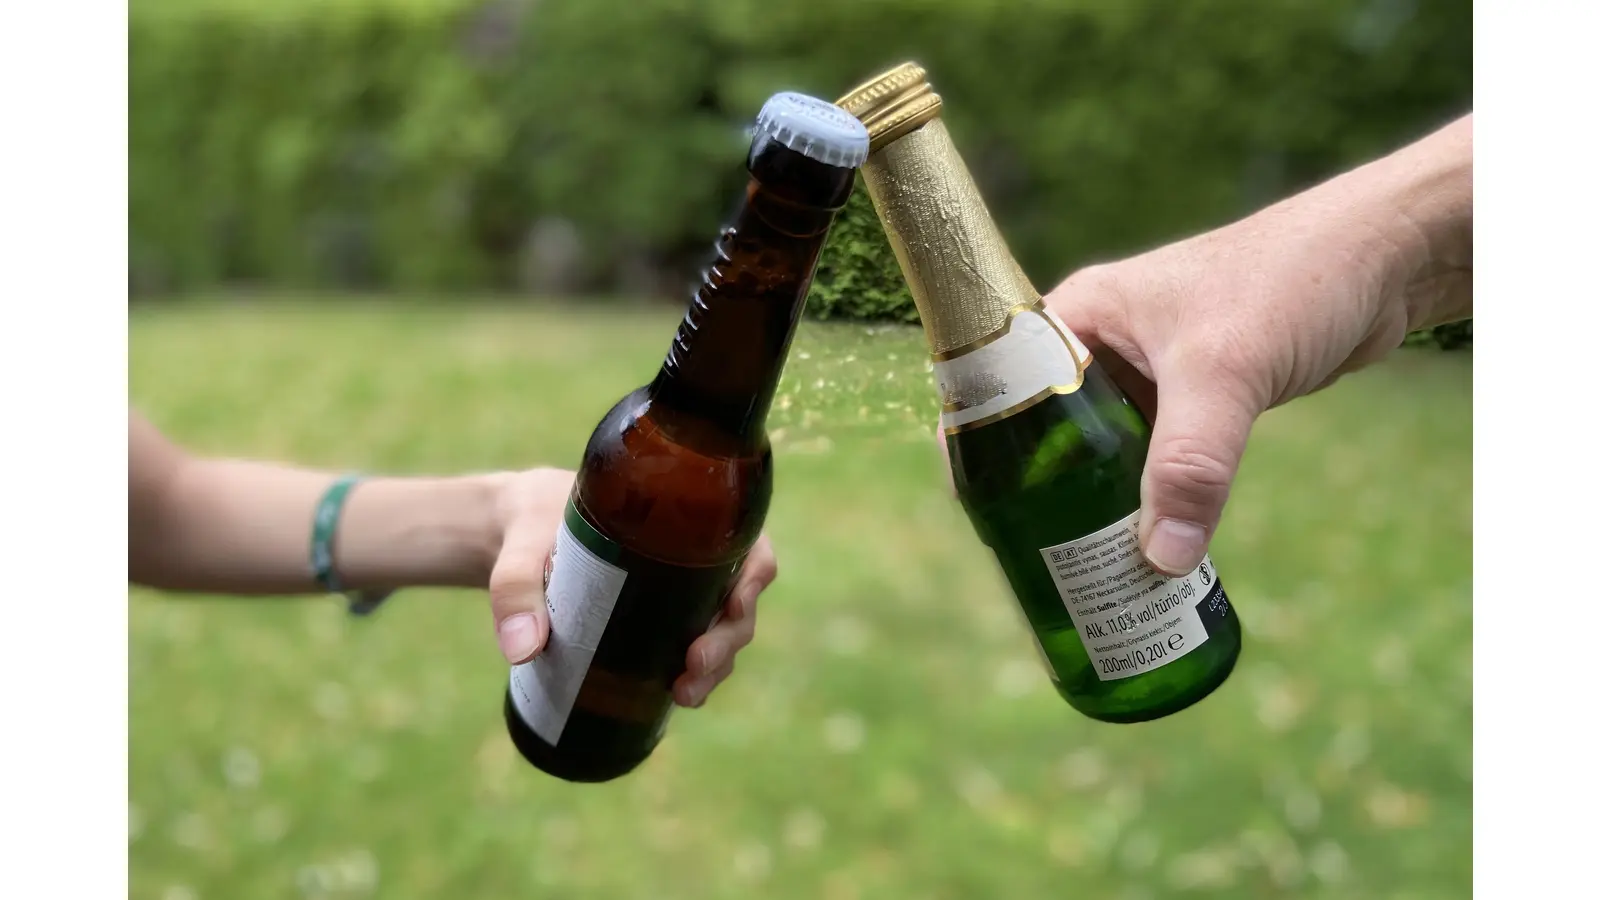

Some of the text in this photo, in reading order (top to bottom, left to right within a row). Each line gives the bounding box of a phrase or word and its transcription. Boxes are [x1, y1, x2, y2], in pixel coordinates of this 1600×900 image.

[1085, 622, 1109, 640] Alk.
[1105, 612, 1137, 635] 11,0%
[1098, 641, 1168, 674] 200ml/0,20l
